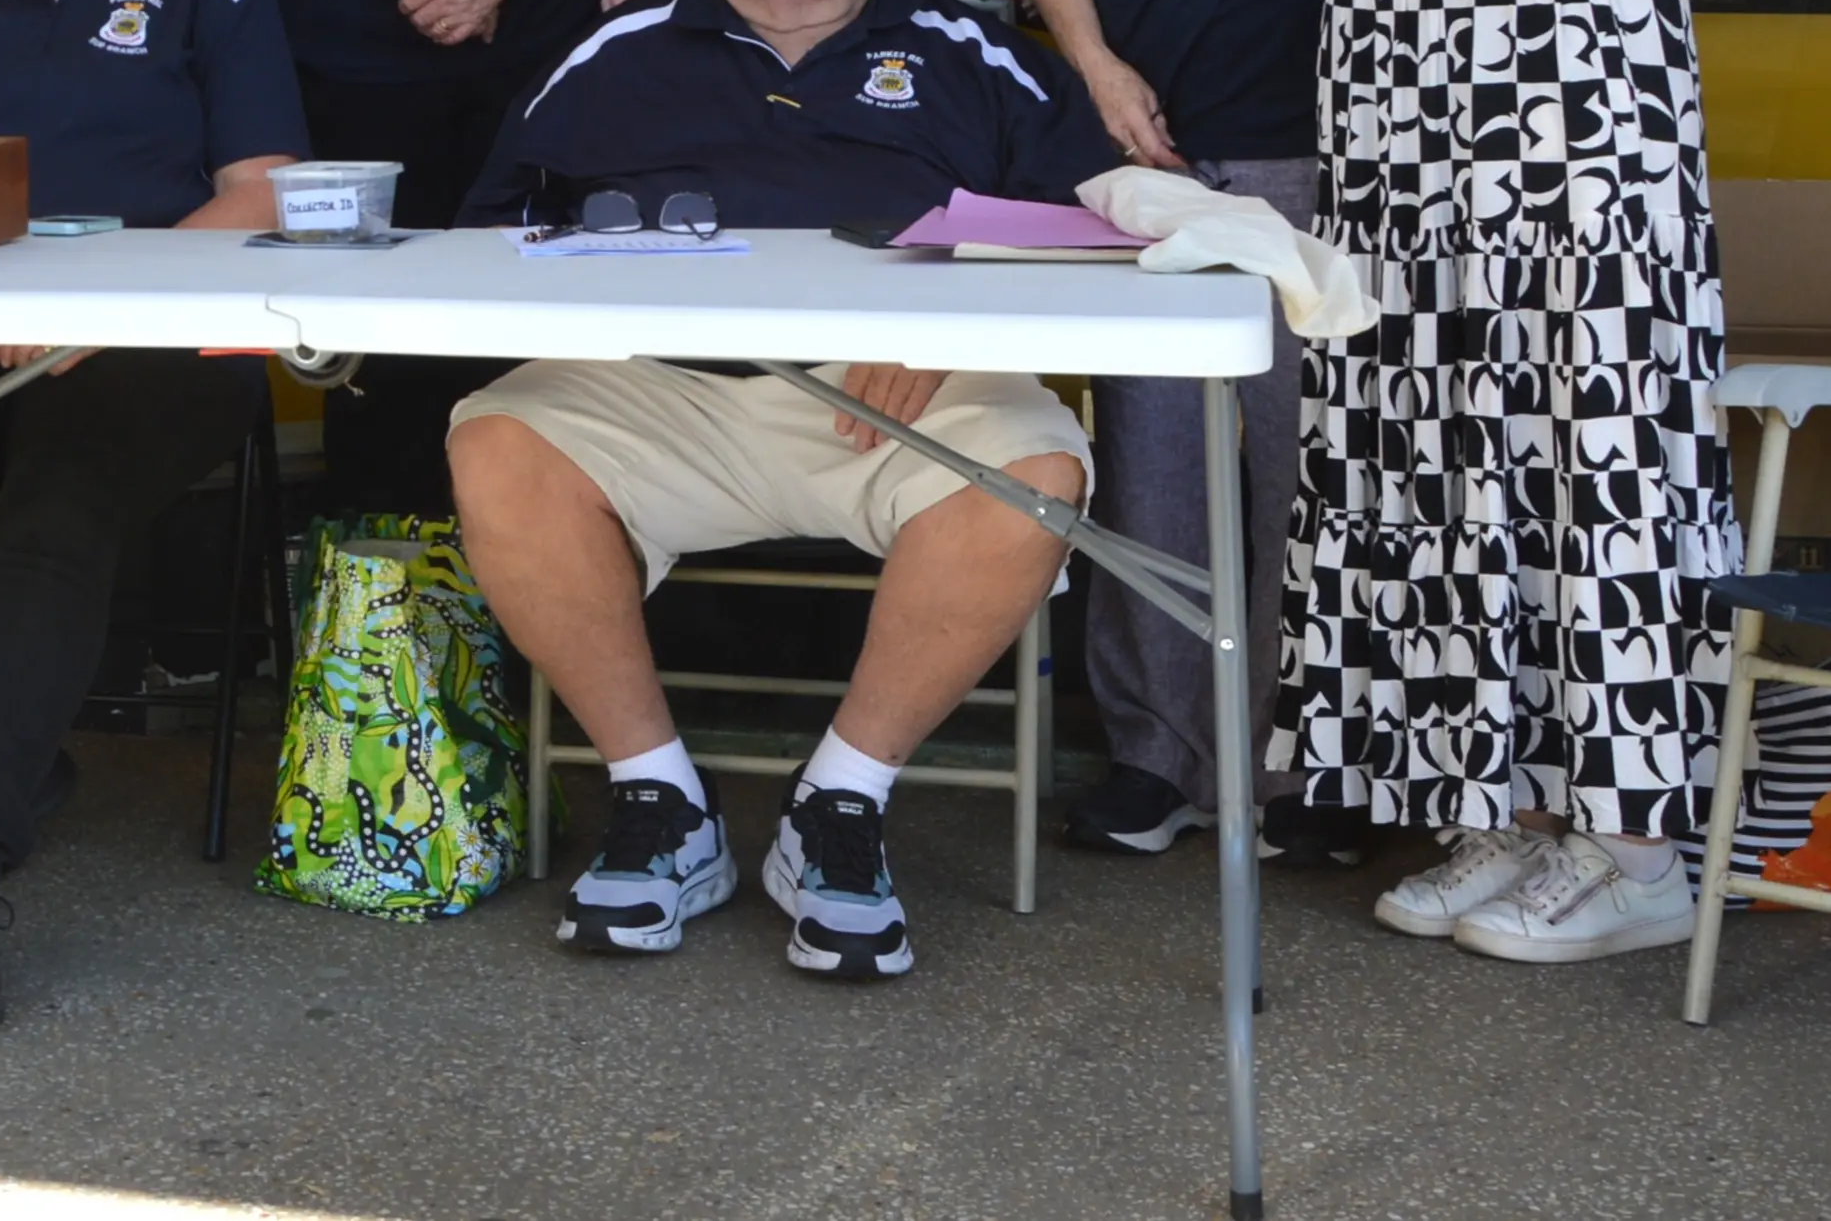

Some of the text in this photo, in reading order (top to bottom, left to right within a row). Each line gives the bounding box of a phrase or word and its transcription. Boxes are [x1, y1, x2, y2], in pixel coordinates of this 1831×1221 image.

[866, 50, 906, 60] PARKES
[287, 198, 355, 214] COLLECTOR ID
